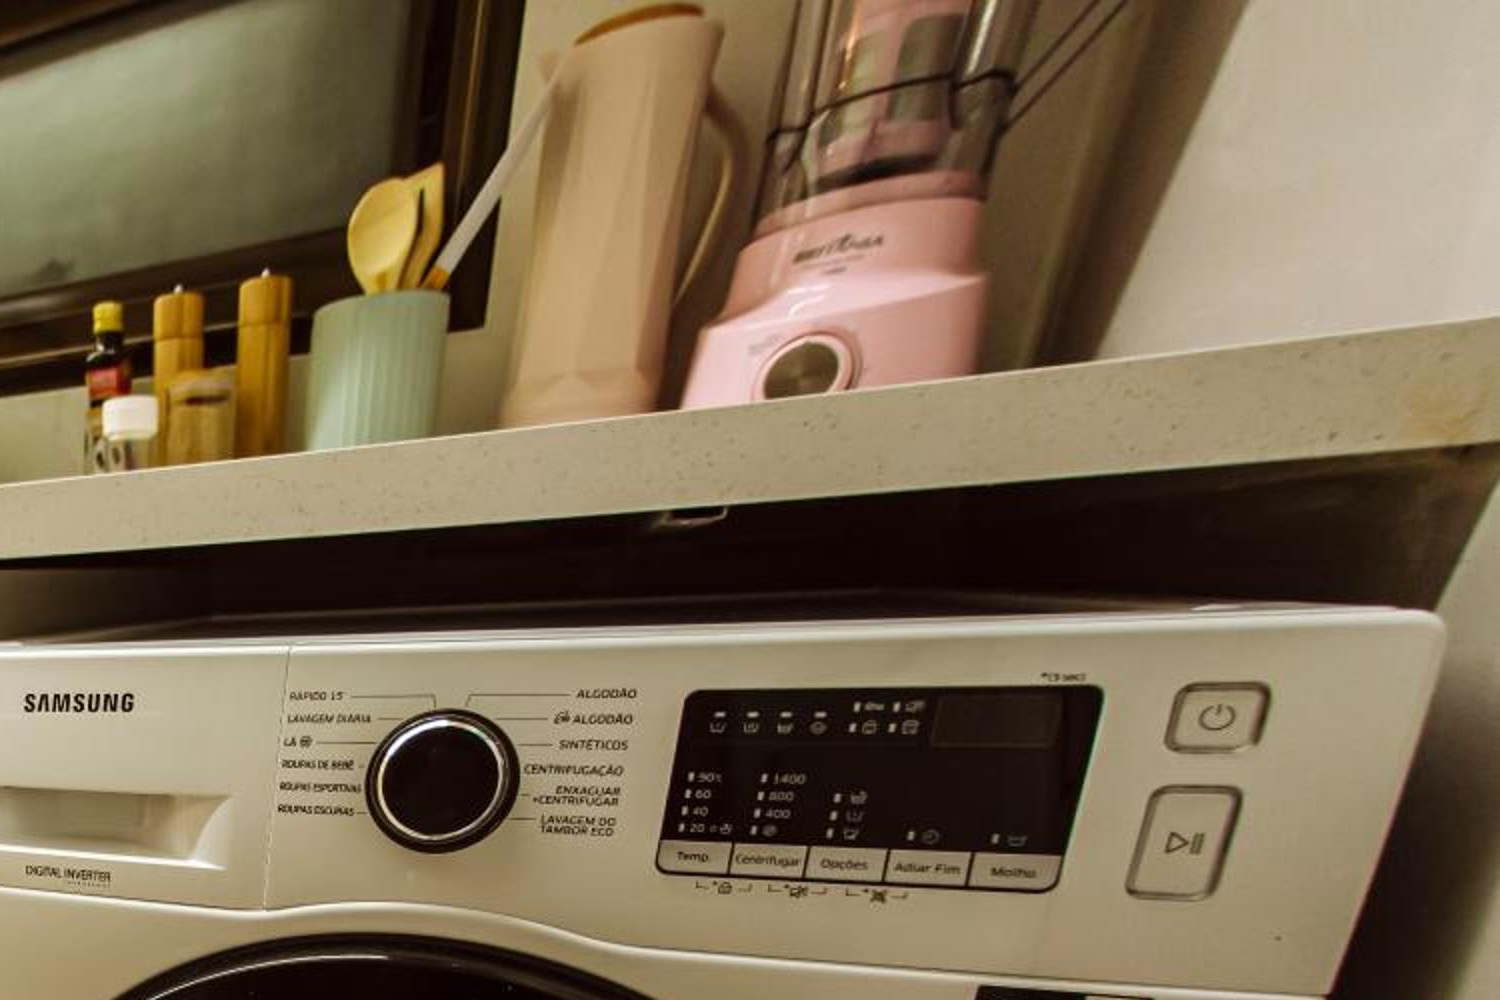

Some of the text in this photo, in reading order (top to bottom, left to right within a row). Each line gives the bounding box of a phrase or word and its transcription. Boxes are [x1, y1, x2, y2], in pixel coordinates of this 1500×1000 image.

[577, 687, 637, 699] ALGODÃO
[24, 693, 134, 712] SAMSUNG
[287, 713, 334, 723] LAVAGEM
[572, 713, 633, 725] ALGODÃO
[559, 739, 628, 751] SINTÉTICOS
[524, 763, 624, 777] CENTRIFUGAÇÃO
[773, 773, 807, 784] 1400
[555, 785, 621, 796] ENXAGUAR
[694, 789, 712, 799] 60
[692, 806, 709, 817] 40
[765, 808, 791, 819] 400
[540, 814, 617, 827] LAVAGEM DO
[540, 825, 614, 837] TAMBOR ECO
[735, 854, 800, 868] Centrifugar
[820, 857, 868, 871] Opções
[25, 865, 62, 878] DIGITAL
[934, 863, 961, 875] Fim
[990, 867, 1037, 878] Molho
